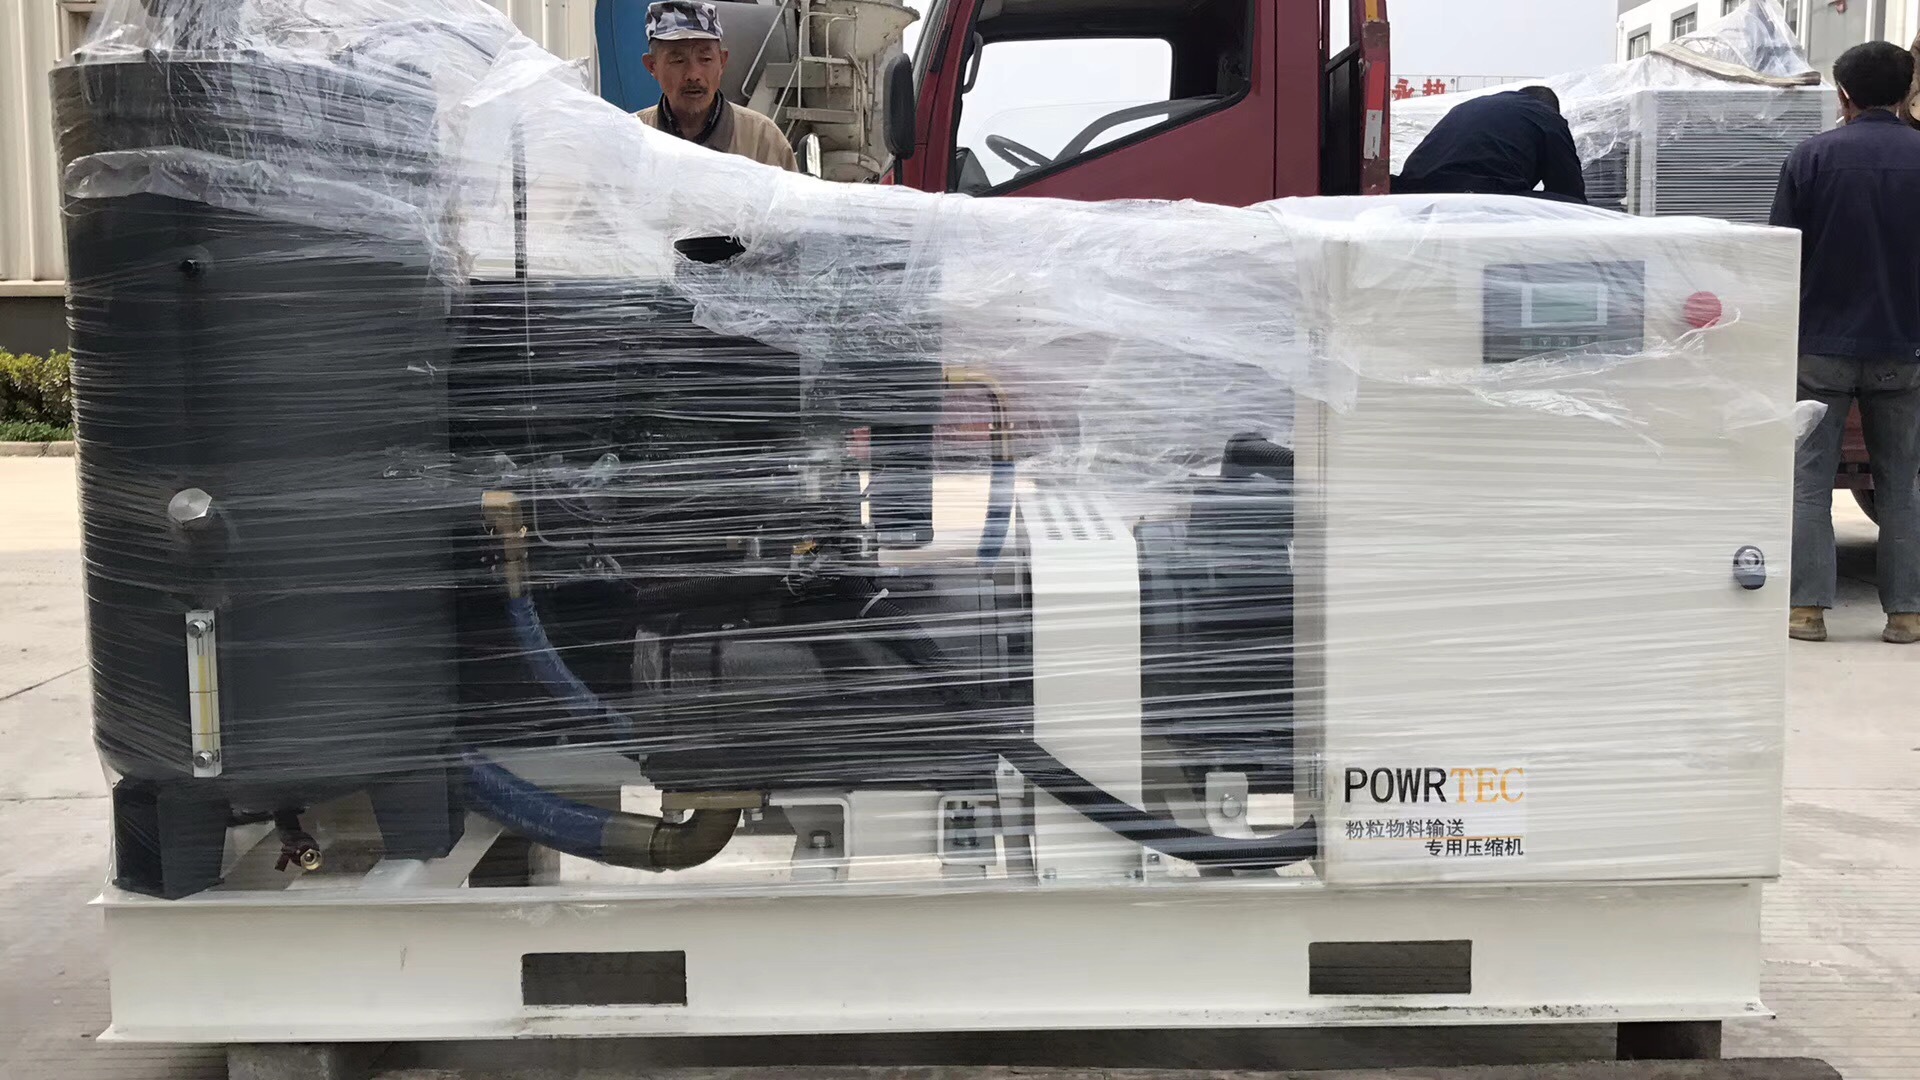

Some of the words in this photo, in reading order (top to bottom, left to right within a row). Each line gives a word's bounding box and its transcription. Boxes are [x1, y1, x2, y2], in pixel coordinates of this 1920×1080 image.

[1344, 767, 1524, 803] POWRTEC
[1345, 819, 1464, 839] 粉粒物料输送
[1424, 837, 1524, 857] 专用压缩机
